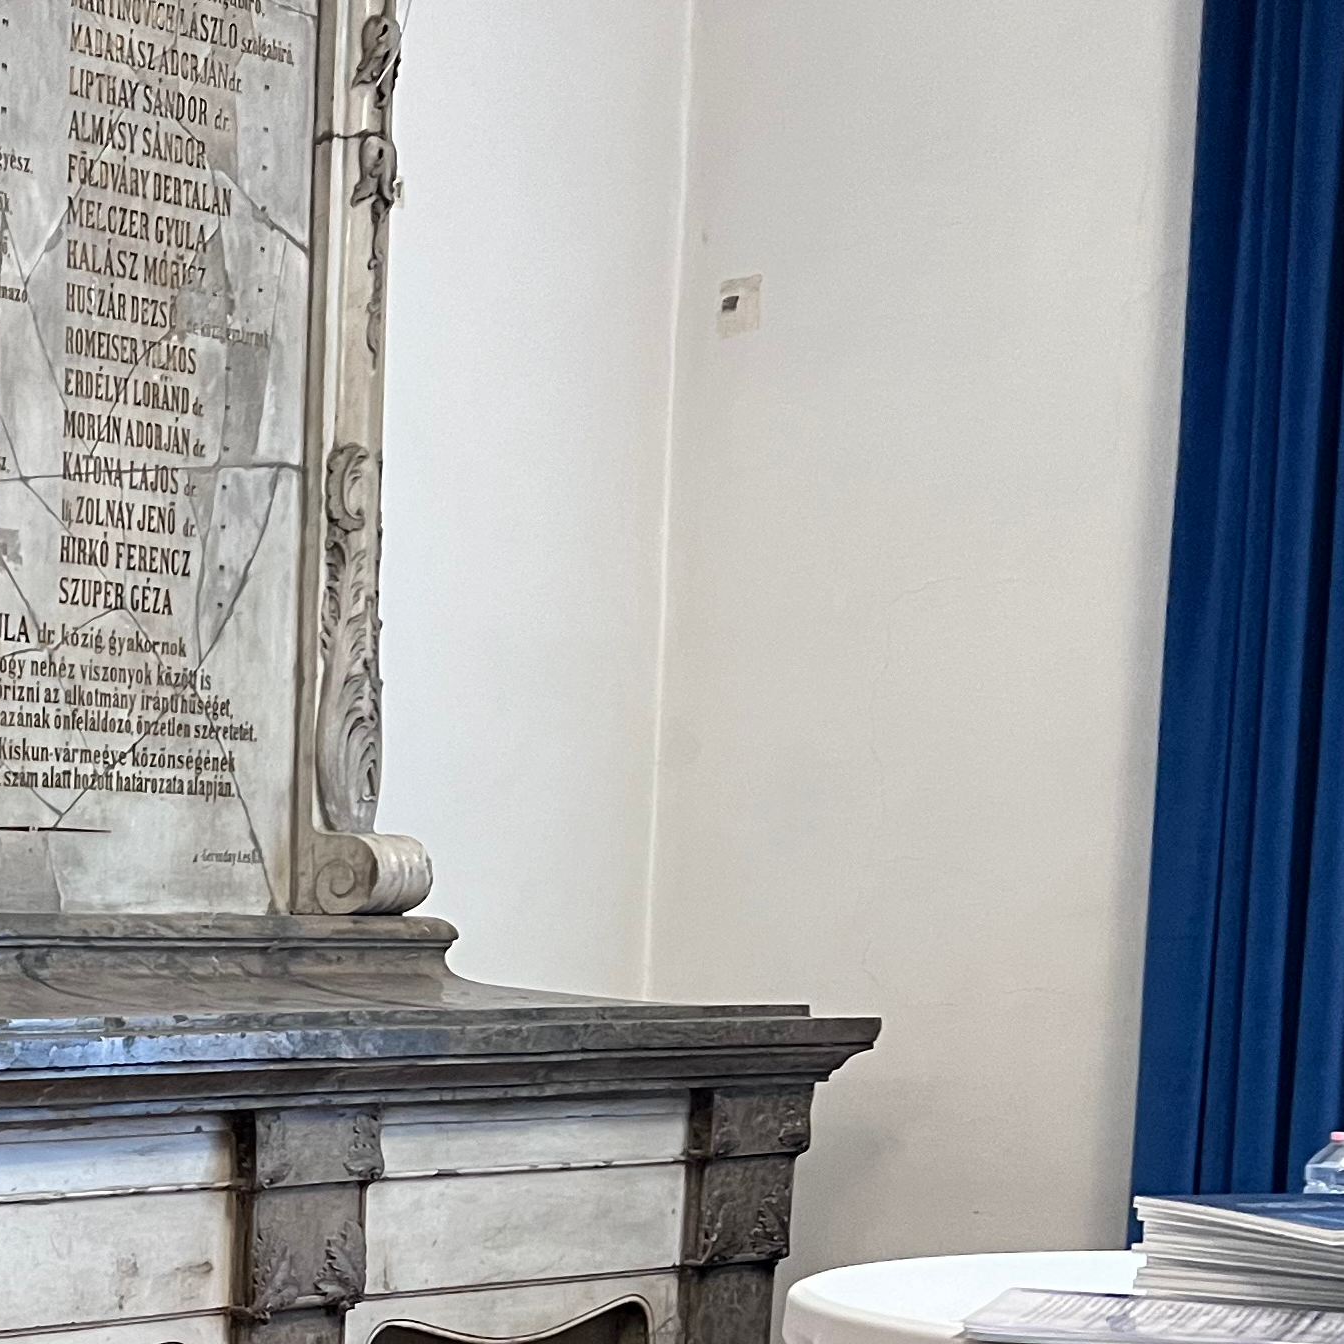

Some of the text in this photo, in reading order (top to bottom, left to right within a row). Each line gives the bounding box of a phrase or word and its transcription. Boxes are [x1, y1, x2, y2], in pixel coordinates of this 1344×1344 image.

[142, 78, 207, 126] SÁNDOR
[67, 109, 206, 170] ALMÁSY SÁNDOR
[66, 196, 206, 253] MELCZER GYULA
[75, 496, 135, 531] ZOLNAY
[59, 531, 191, 577] HIRKÓ FERENCZ
[58, 576, 173, 616] SZUPER GÉZA
